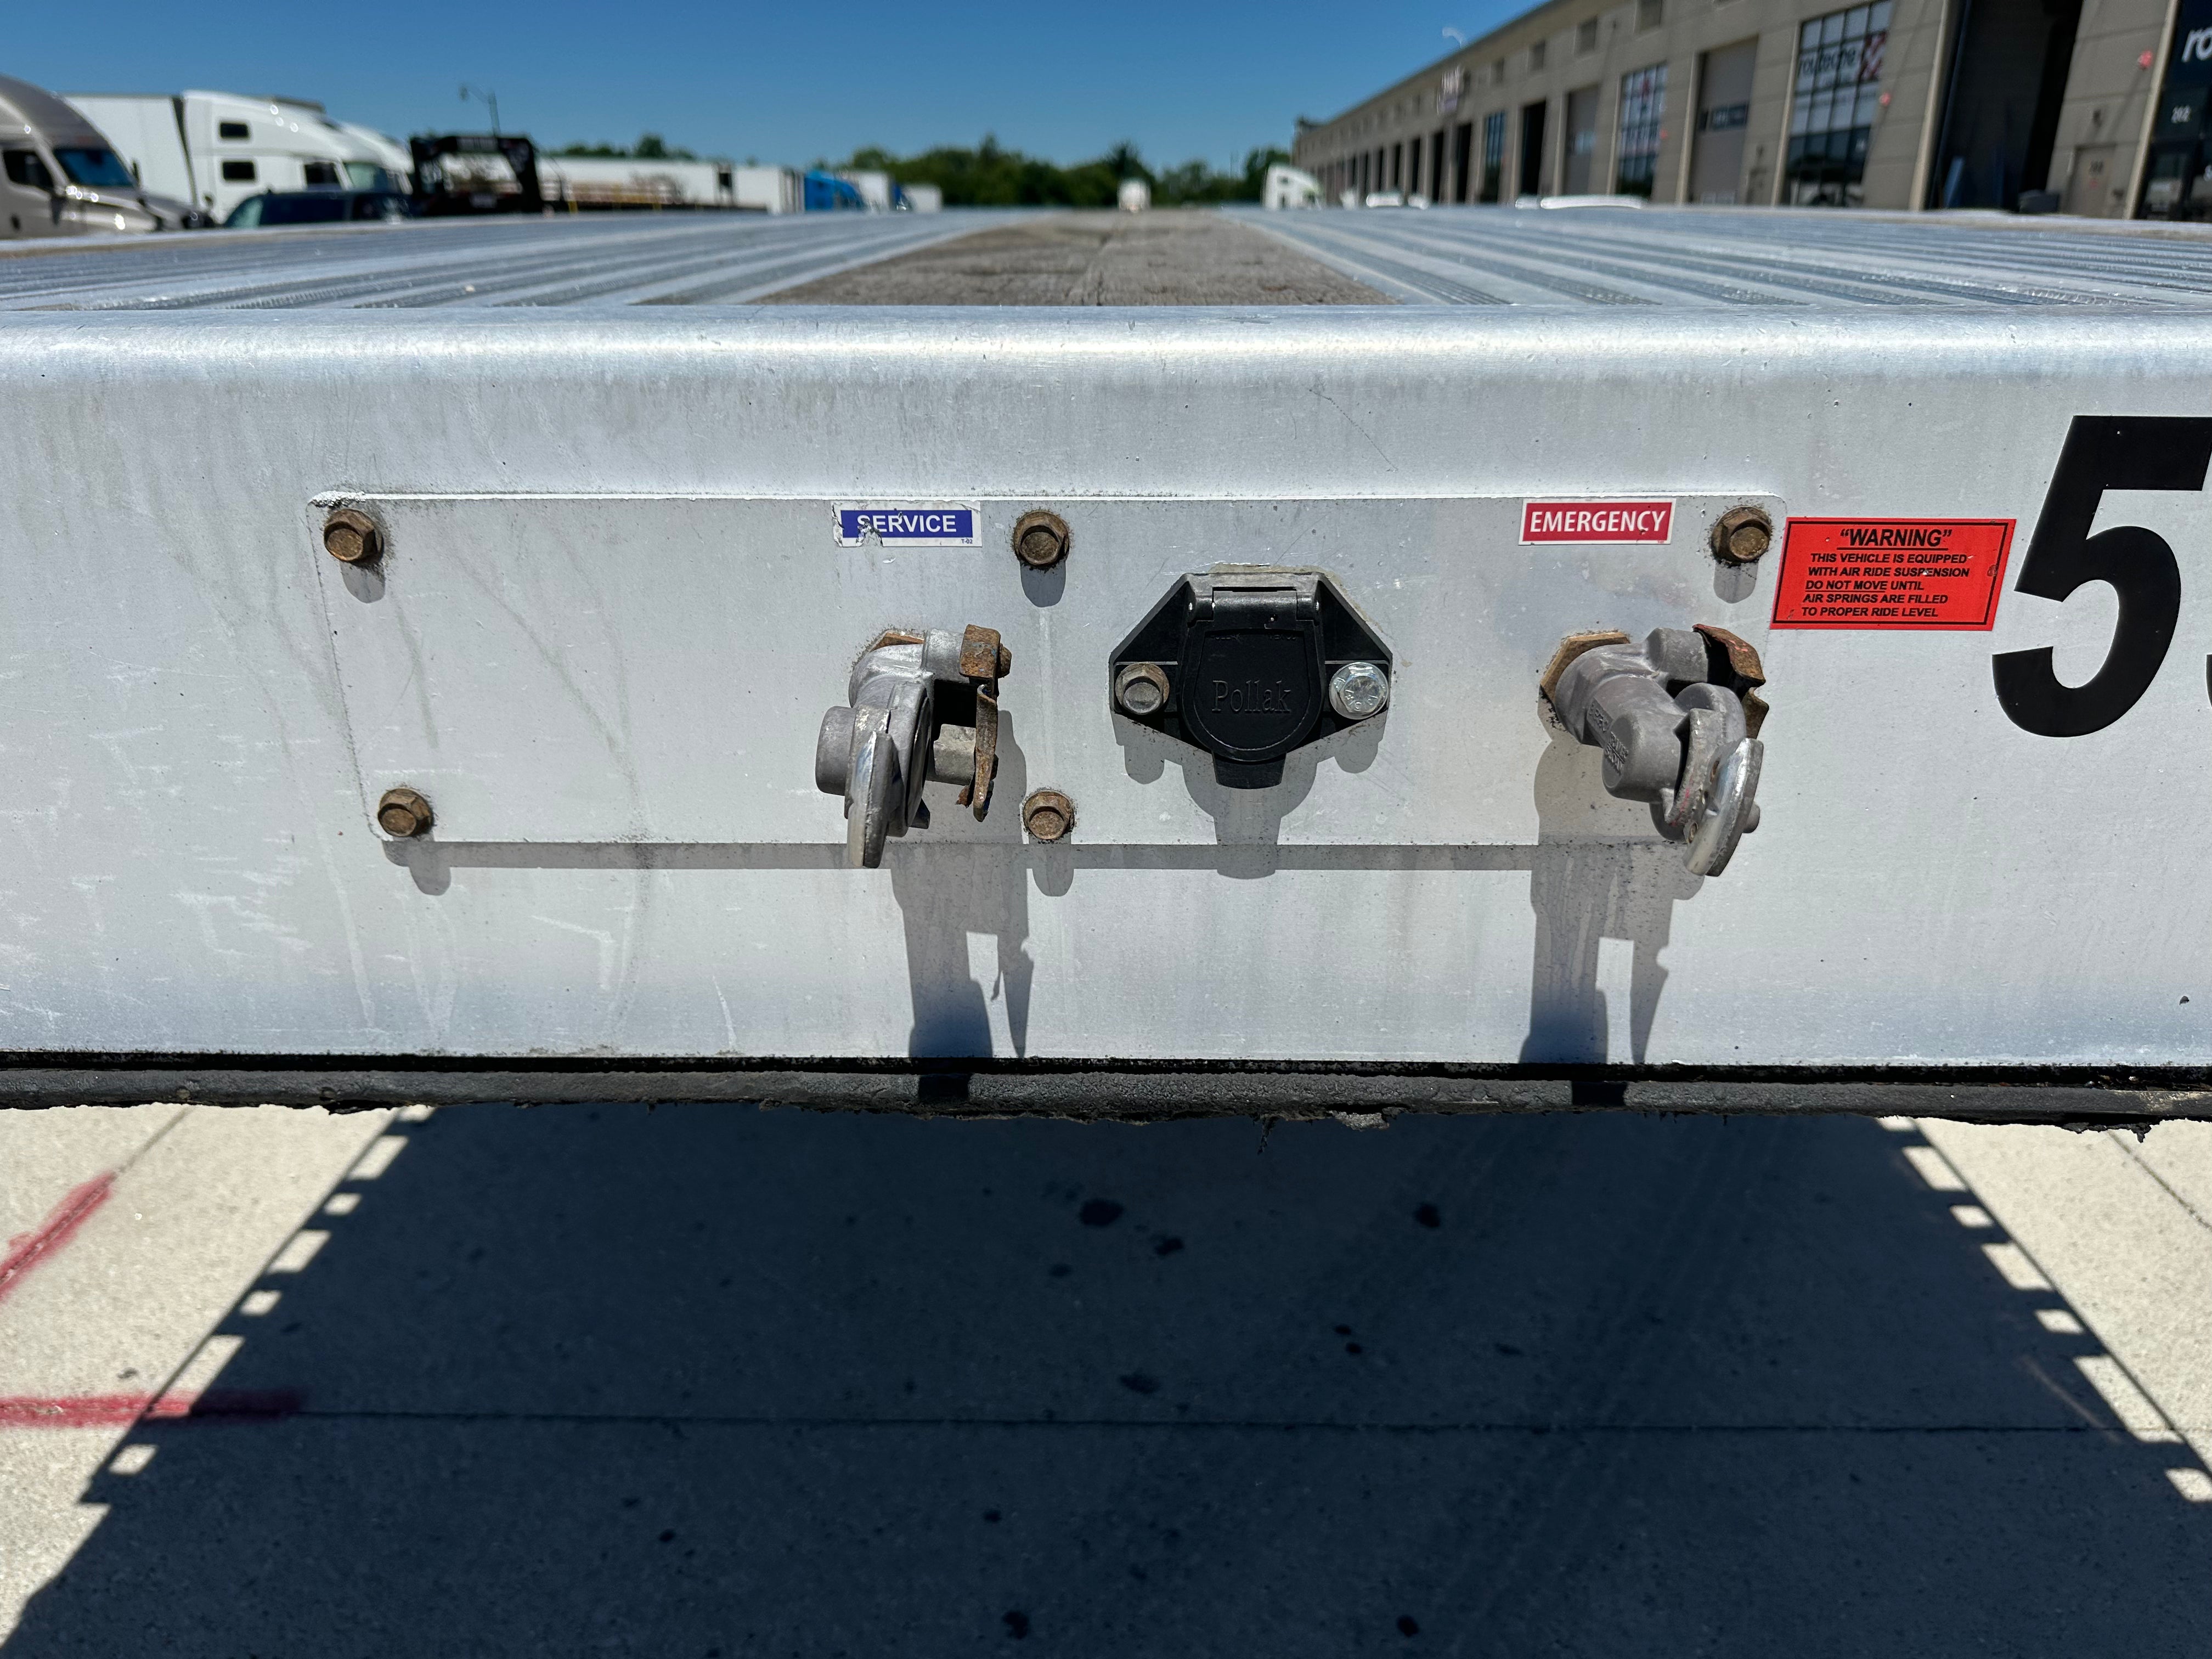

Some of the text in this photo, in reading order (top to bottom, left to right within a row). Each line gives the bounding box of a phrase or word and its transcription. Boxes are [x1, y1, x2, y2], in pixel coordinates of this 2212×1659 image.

[856, 514, 957, 533] SERVICE
[1530, 510, 1666, 533] EMERGENCY
[1810, 553, 1967, 564] THIS VEHICLE IS EQUIPPED
[1808, 567, 1970, 577] WITH AIR RIDE SUSPENSION
[1805, 580, 1924, 590] DO NOT MOVE UNTIL
[1803, 594, 1948, 603] AIR SPRINGS ARE FILLED
[1802, 607, 1938, 617] TO PROPER RIDE LEVEL
[1211, 679, 1291, 714] Pollak
